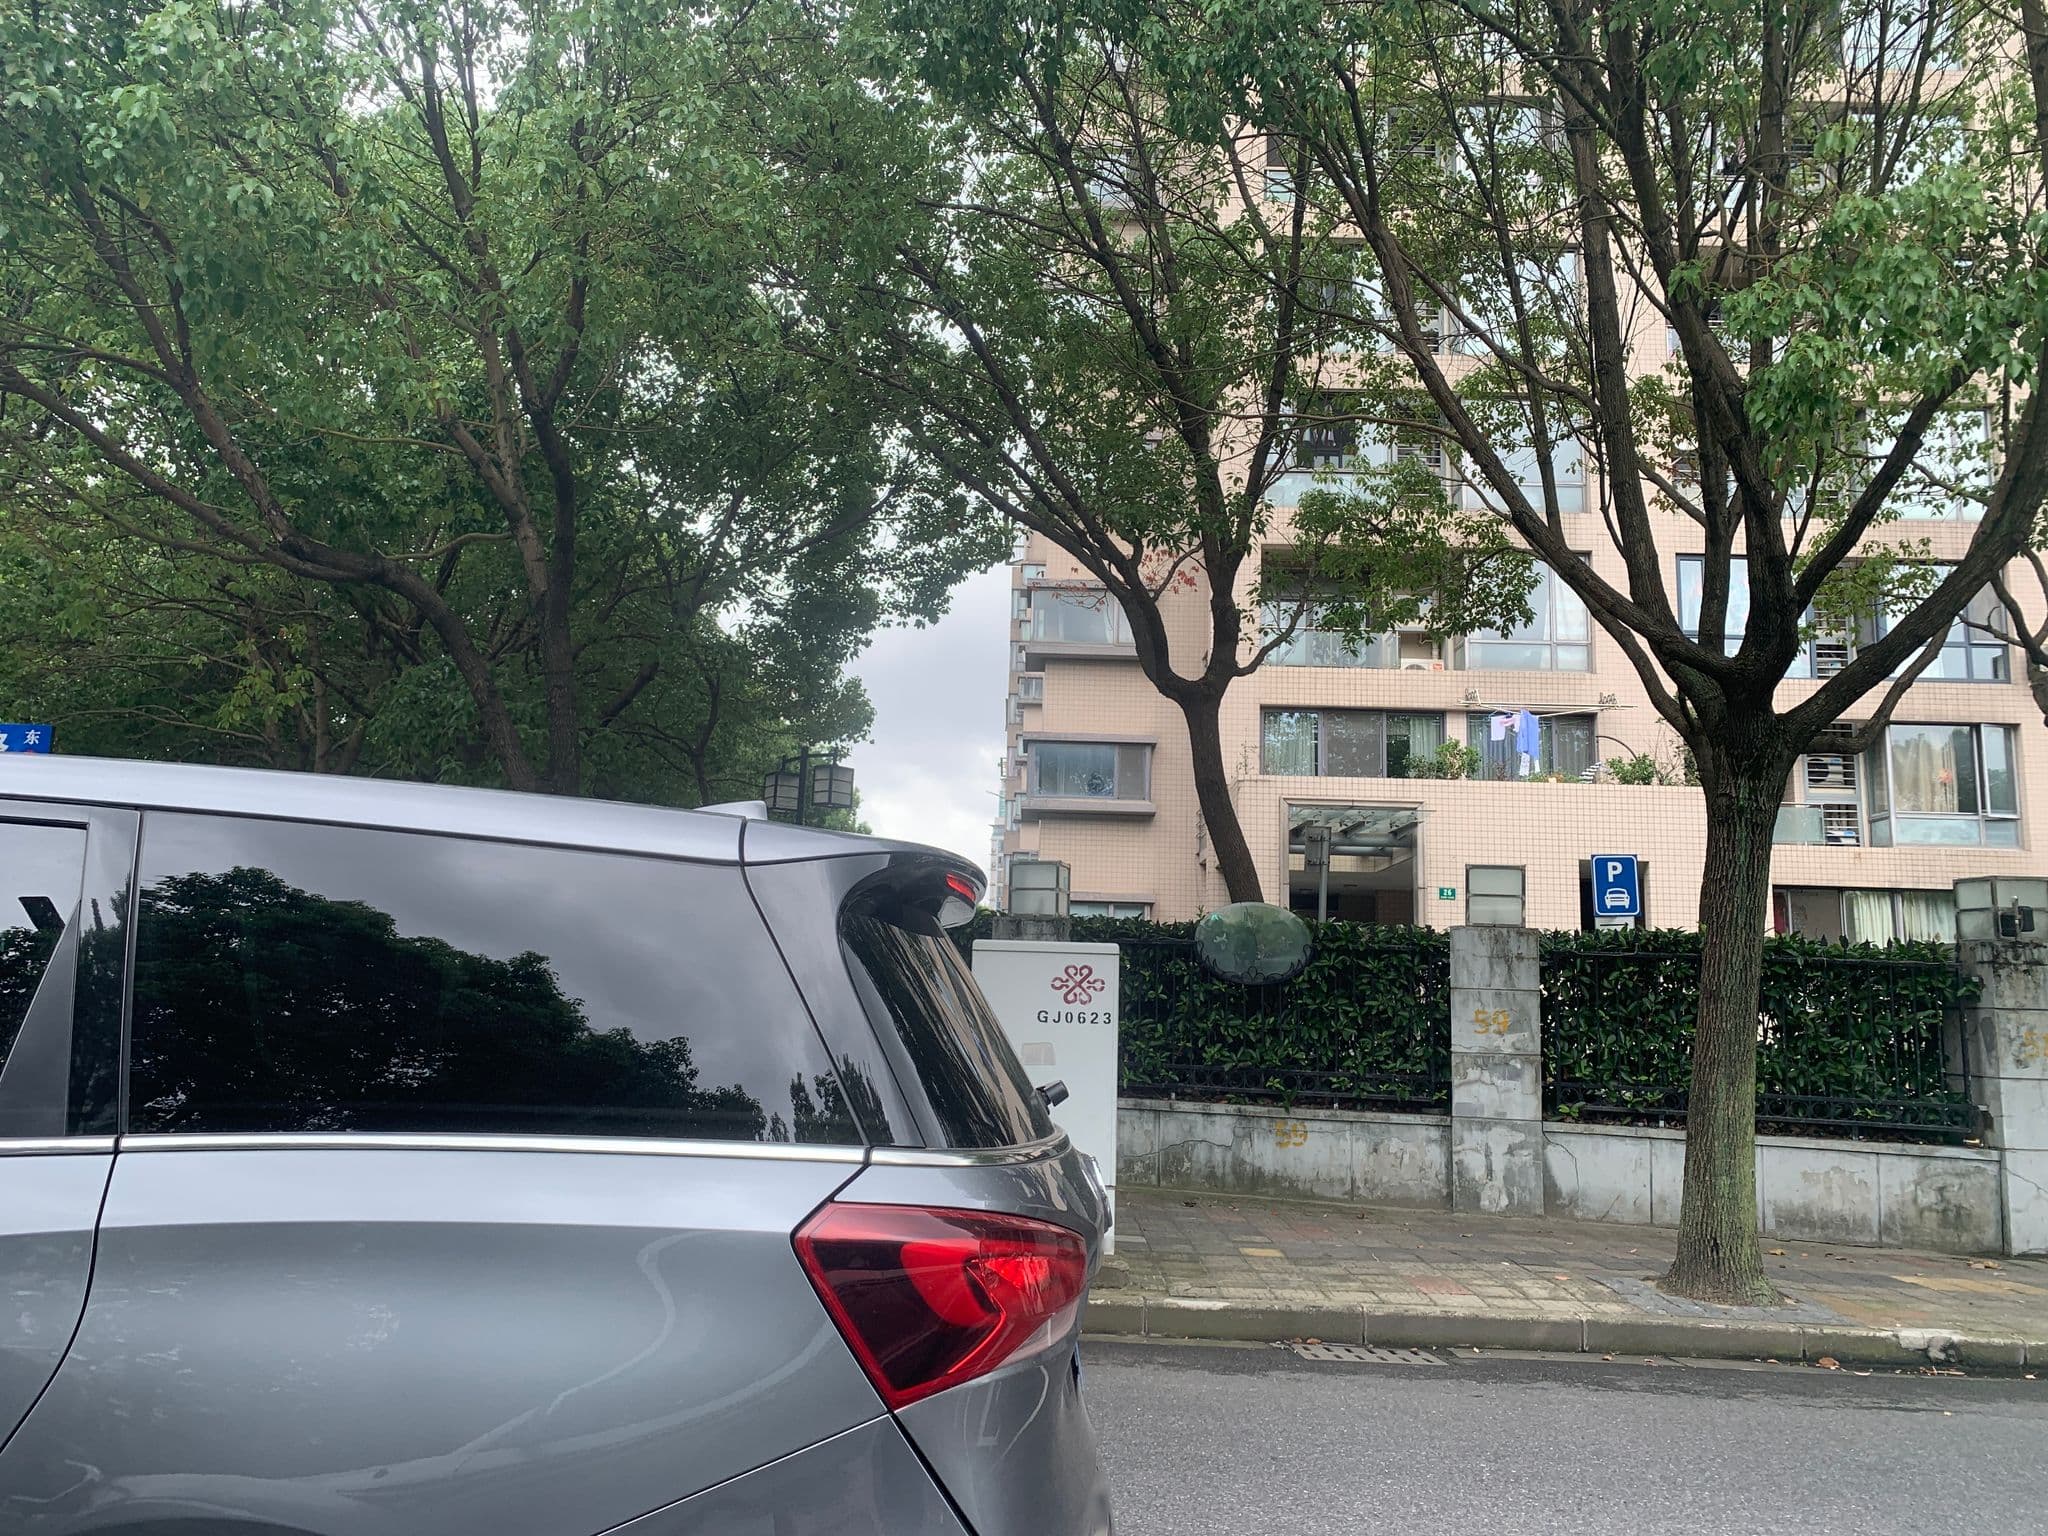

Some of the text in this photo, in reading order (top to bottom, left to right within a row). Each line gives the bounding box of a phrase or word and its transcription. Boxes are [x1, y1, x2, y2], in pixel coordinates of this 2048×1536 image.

[23, 729, 41, 745] 东
[1607, 861, 1623, 882] P
[1037, 1010, 1111, 1025] GJ0623
